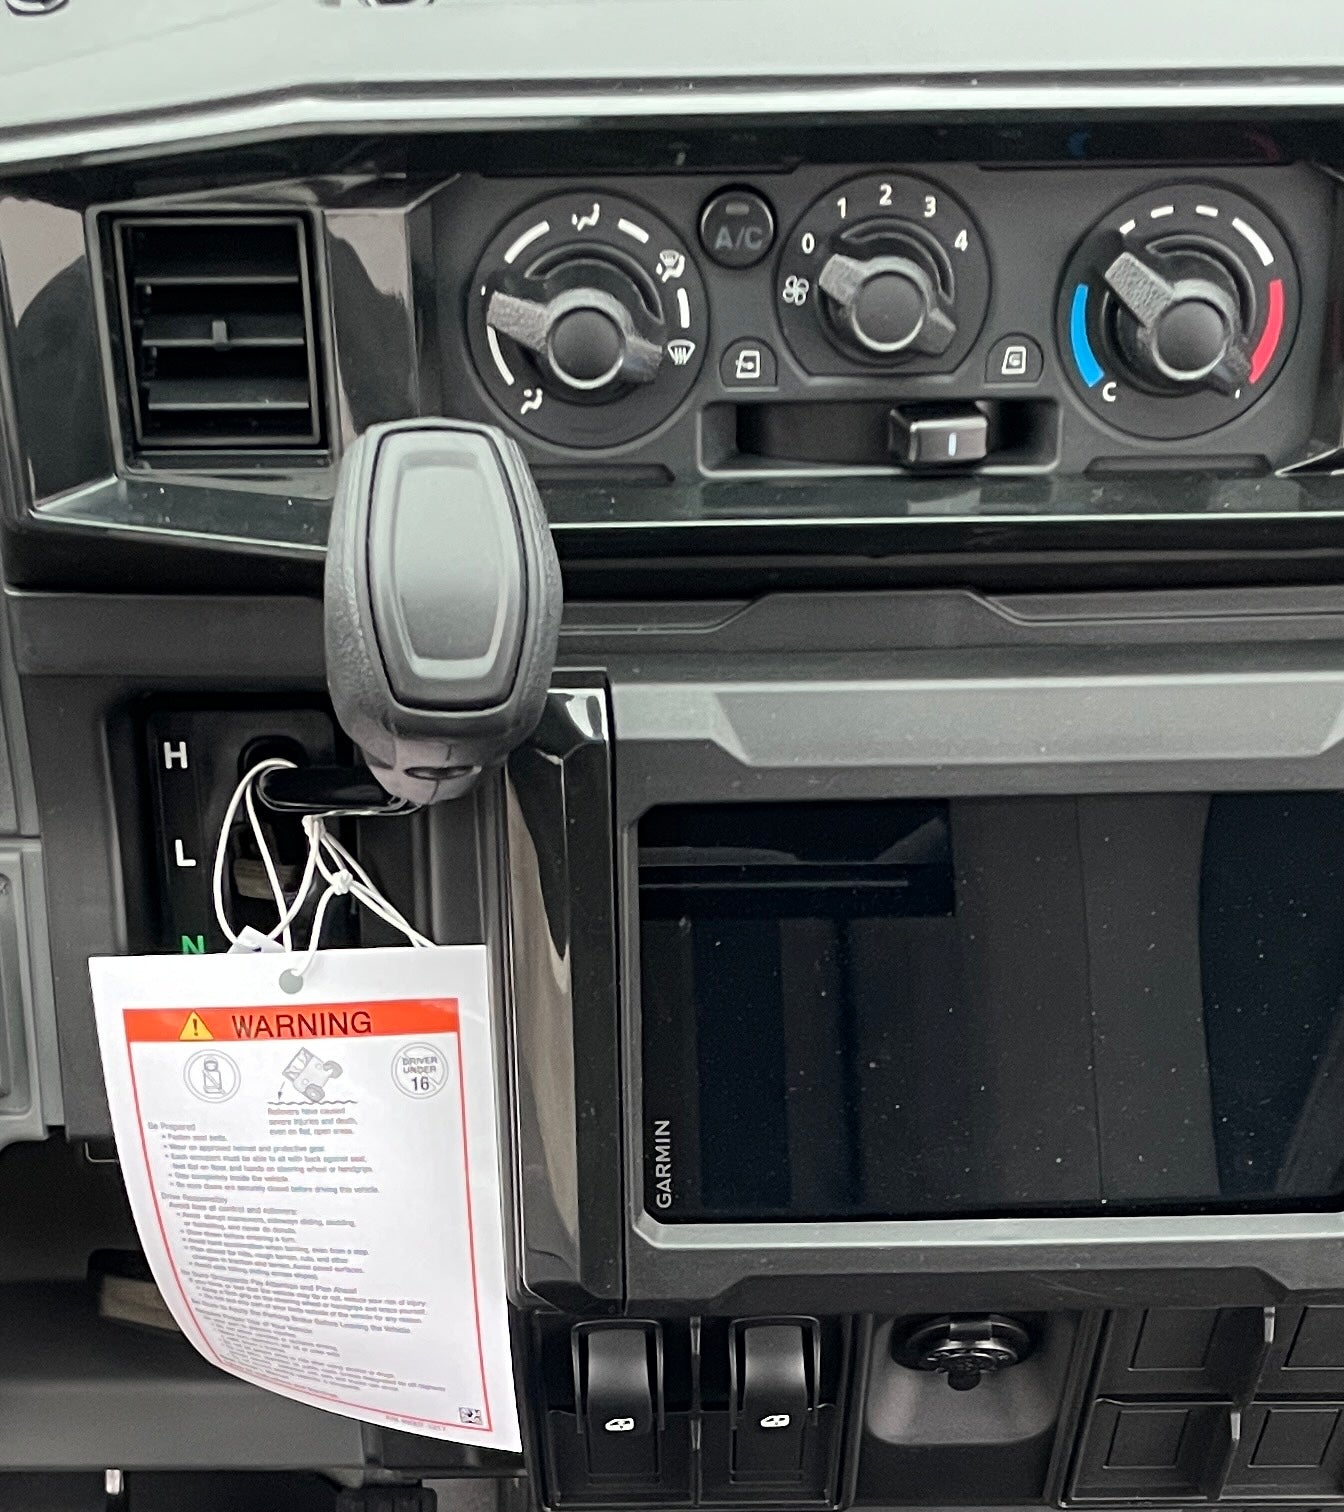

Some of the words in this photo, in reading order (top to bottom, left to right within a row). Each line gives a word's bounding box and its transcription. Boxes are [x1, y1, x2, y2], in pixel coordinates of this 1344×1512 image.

[802, 233, 815, 254] 0
[837, 197, 848, 218] 1
[879, 184, 892, 206] 2
[924, 195, 937, 218] 3
[954, 229, 968, 251] 4
[715, 226, 763, 249] A/C
[1102, 381, 1117, 403] C
[163, 741, 188, 769] H
[175, 839, 196, 867] L
[181, 935, 205, 954] N
[232, 1011, 373, 1038] WARNING
[402, 1056, 438, 1066] DRIVER
[411, 1076, 430, 1091] 16
[654, 1120, 672, 1209] GARMIN
